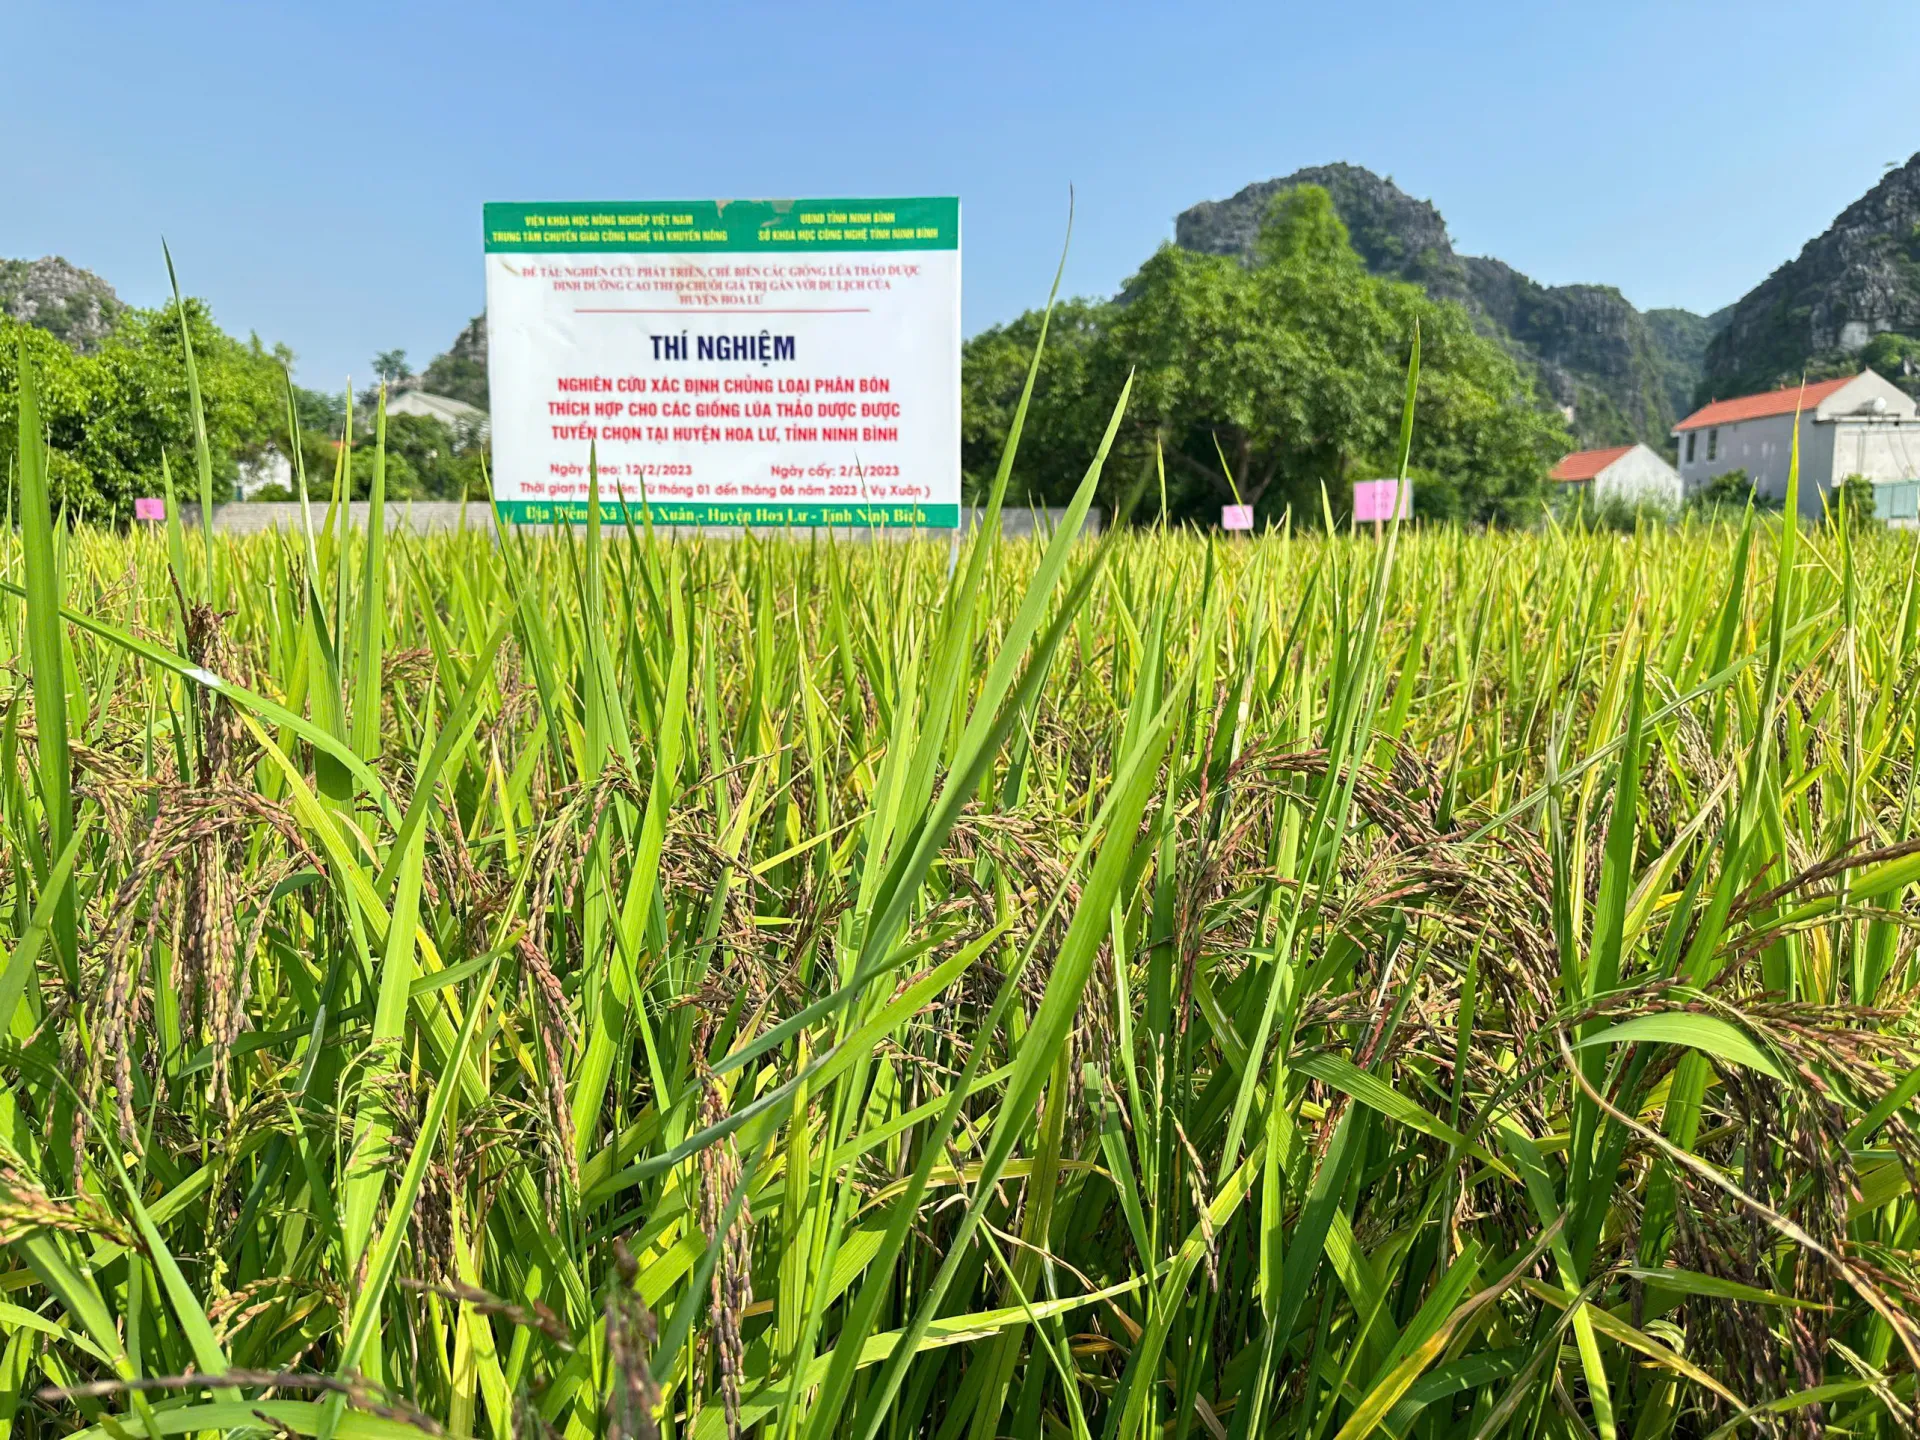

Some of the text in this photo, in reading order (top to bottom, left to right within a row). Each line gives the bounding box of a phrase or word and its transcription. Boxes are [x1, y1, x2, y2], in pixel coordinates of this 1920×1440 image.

[525, 213, 693, 227] VIỆN KHOA HỌC NÔNG NGHIỆP VIỆT NAM
[493, 231, 521, 241] TRUNG
[523, 230, 542, 241] TÂM
[580, 231, 600, 241] GIAO
[602, 230, 626, 241] CÔNG
[628, 231, 650, 243] NGHỆ
[653, 230, 664, 241] VÀ
[703, 230, 728, 241] NÔNG
[650, 330, 796, 367] THÍ NGHIỆM
[558, 375, 890, 396] NGHIÊN CỨU XÁC ĐỊNH CHỦNG LOẠI PHÂN BÓN
[548, 399, 900, 420] THÍCH HỢP CHO CÁC GIỐNG LÚA THẢO DƯỢC ĐƯỢC
[602, 426, 641, 443] CHỌN
[646, 426, 668, 444] TẠI
[673, 425, 720, 444] HUYỆN
[725, 428, 753, 441] HOA
[758, 426, 780, 443] LƯ,
[785, 424, 817, 441] TỈNH
[822, 427, 857, 441] NINH
[863, 424, 897, 441] BÌNH
[550, 464, 583, 476] Ngày
[625, 465, 692, 476] 12/2/2023
[771, 462, 899, 478] Ngày cấy: 2/3/2023
[520, 482, 545, 493] Thời
[548, 484, 575, 496] gian
[579, 482, 604, 494] thc
[658, 482, 693, 497] tháng
[697, 485, 711, 495] 01
[715, 481, 737, 495] đến
[741, 483, 776, 498] tháng
[780, 486, 794, 495] 06
[799, 485, 824, 495] năm
[829, 486, 857, 496] 2023
[870, 486, 886, 497] Vụ
[890, 485, 922, 496] Xuân
[925, 486, 930, 498] )
[756, 507, 783, 522] Hoa
[856, 508, 889, 523] Ninh
